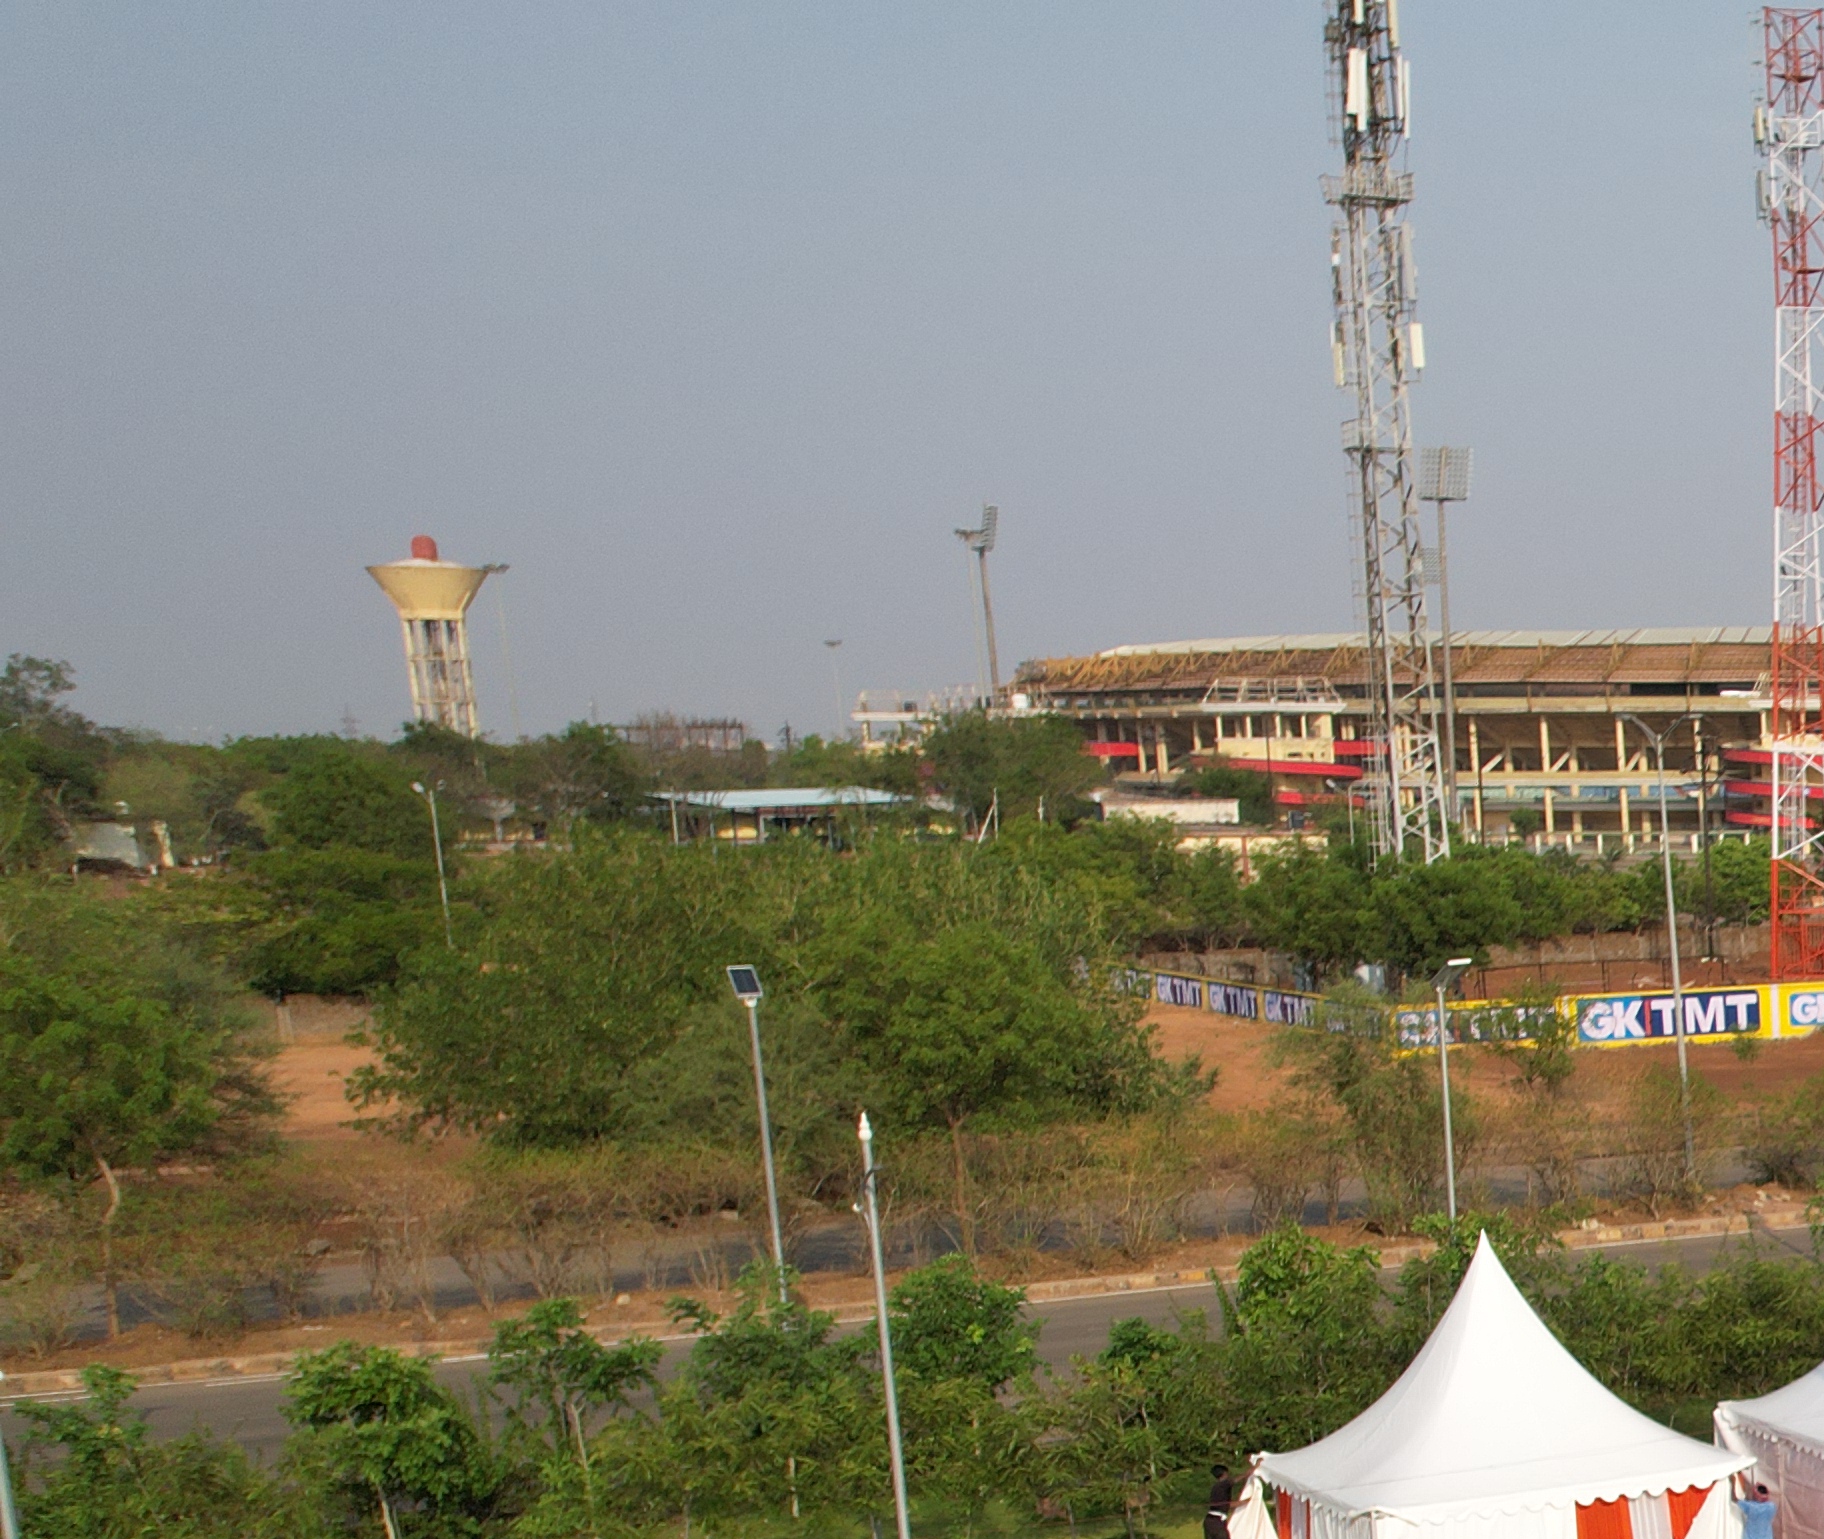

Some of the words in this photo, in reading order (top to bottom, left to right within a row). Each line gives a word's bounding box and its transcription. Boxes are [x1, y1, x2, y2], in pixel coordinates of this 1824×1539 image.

[1157, 974, 1174, 1002] GK
[1174, 977, 1202, 1007] TMT
[1209, 983, 1227, 1012] GK
[1228, 987, 1257, 1018] TMT
[1265, 991, 1283, 1022] GK
[1582, 998, 1646, 1040] GK
[1651, 992, 1758, 1036] TMT
